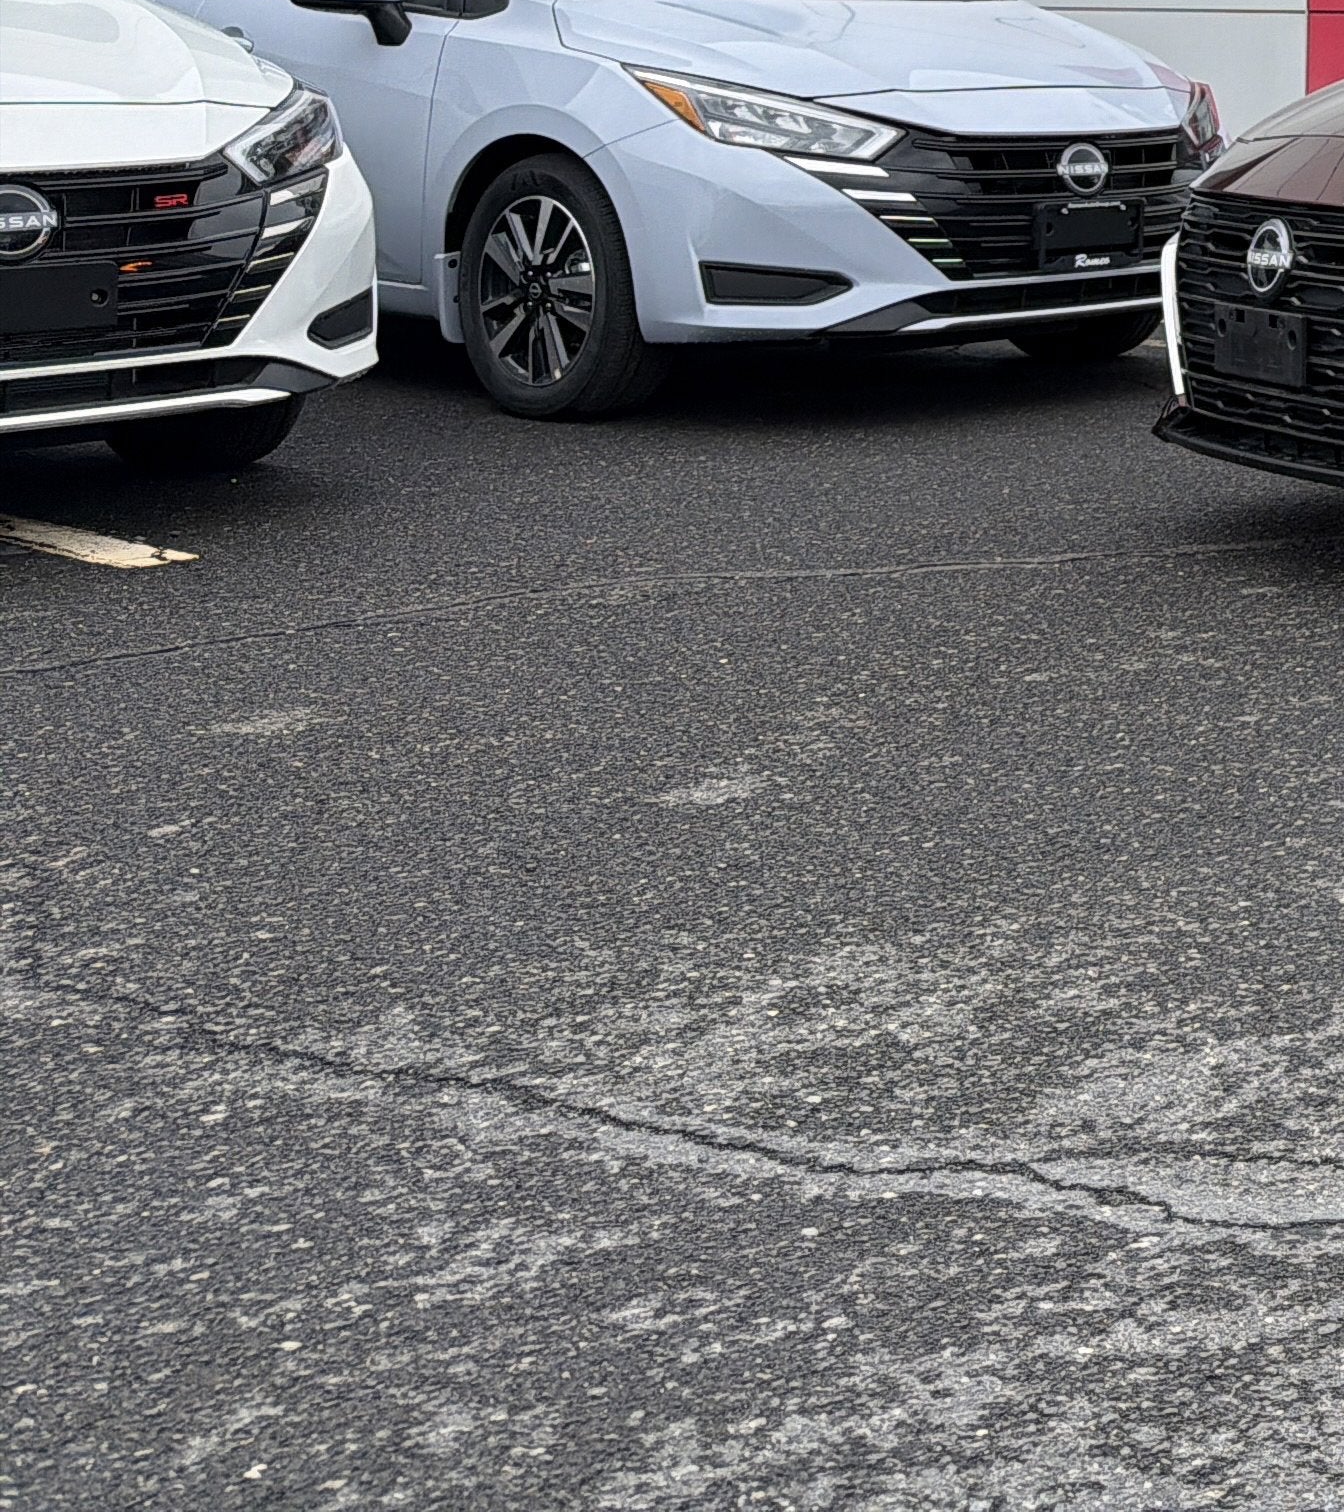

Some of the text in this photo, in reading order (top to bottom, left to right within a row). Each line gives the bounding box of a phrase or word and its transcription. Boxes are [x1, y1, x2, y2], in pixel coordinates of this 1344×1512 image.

[1057, 163, 1109, 175] NISSAN
[153, 193, 189, 208] SR
[1074, 253, 1111, 268] Romeo
